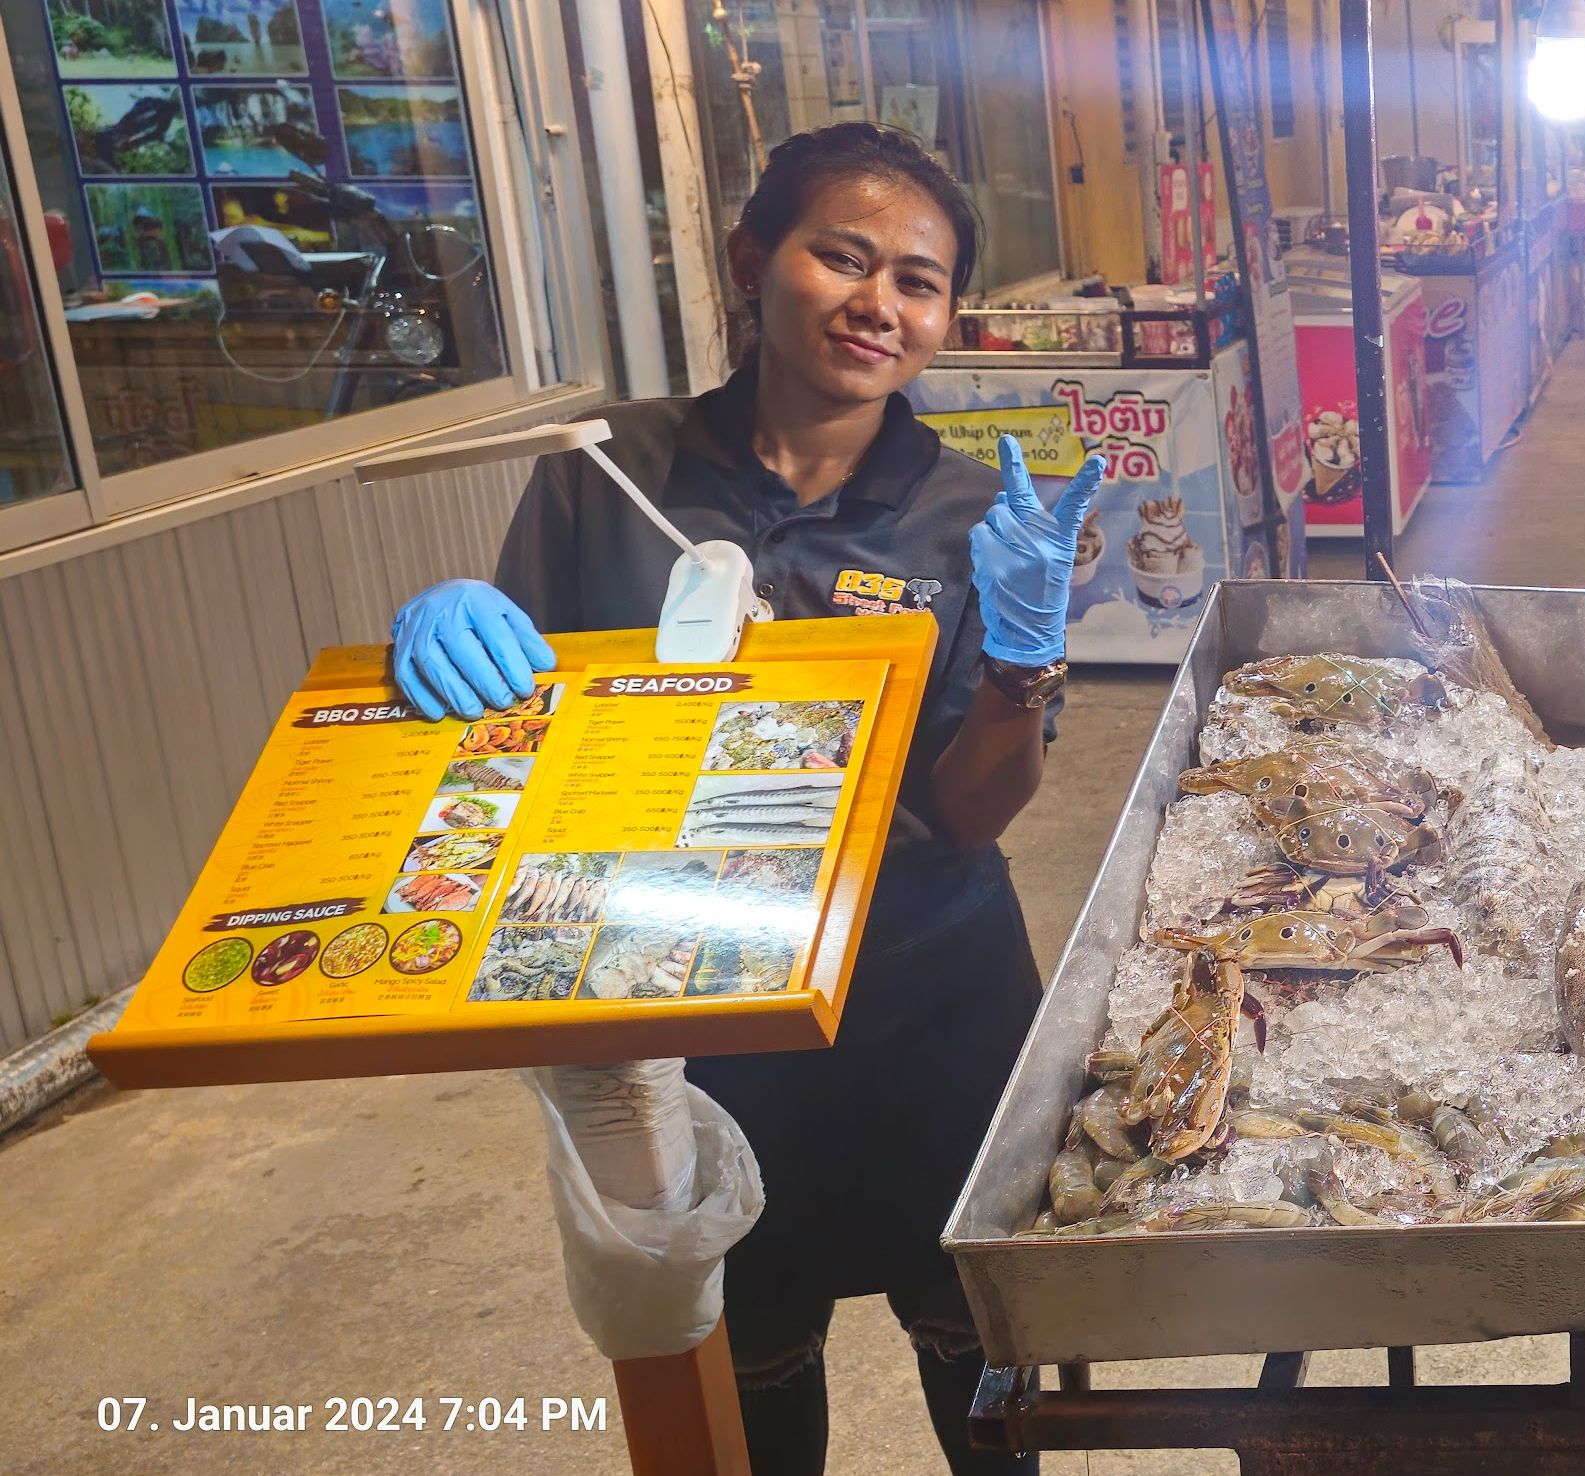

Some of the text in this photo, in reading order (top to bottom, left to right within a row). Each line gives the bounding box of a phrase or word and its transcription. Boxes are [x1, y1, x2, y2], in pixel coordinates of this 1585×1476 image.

[1056, 387, 1166, 438] ไอติม
[949, 424, 984, 440] Whip
[608, 677, 733, 693] SEAFOOD
[312, 705, 422, 724] BBQ SEAF
[227, 904, 348, 927] DIPPING SAUCE
[402, 977, 422, 986] Spicy
[423, 977, 447, 985] Salad
